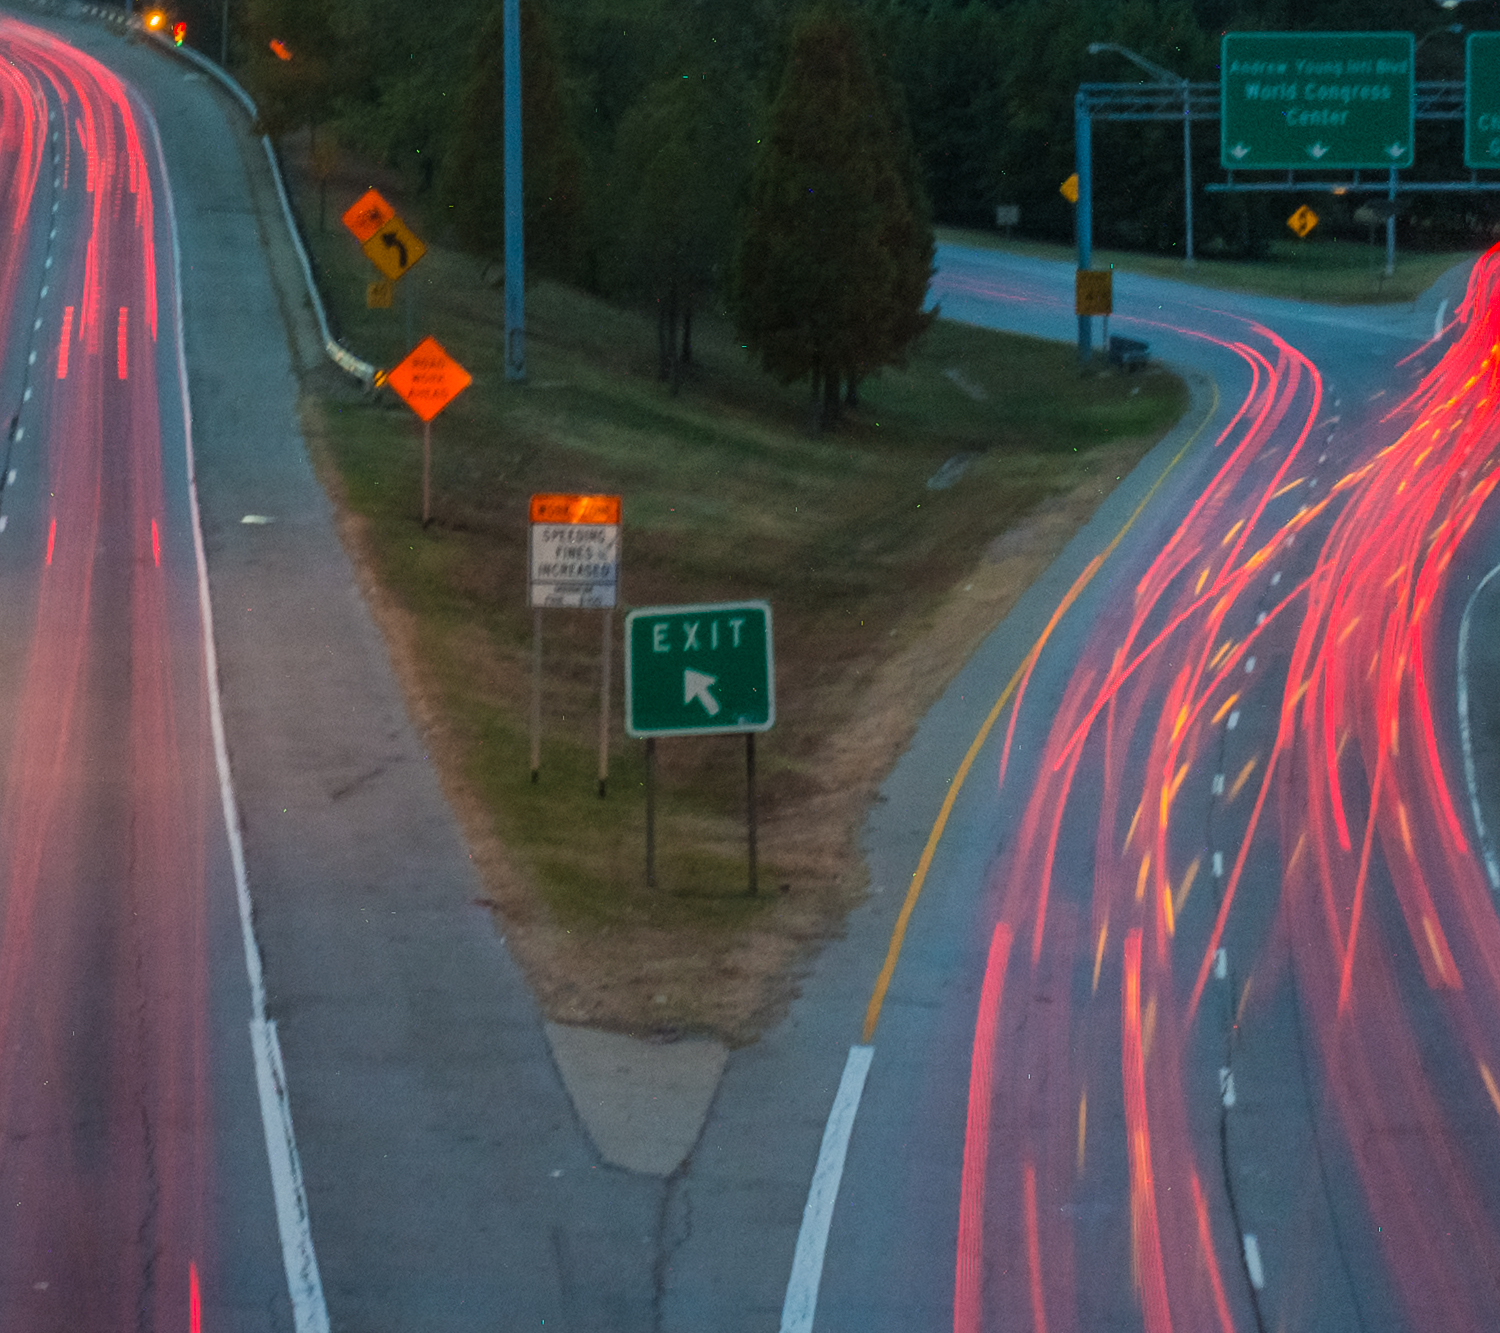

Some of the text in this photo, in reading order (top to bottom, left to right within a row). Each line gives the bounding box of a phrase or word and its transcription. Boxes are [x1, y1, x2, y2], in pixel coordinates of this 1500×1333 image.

[1229, 59, 1288, 76] Andrew
[1295, 58, 1343, 78] Young
[1244, 81, 1393, 104] World Congress
[1285, 106, 1349, 127] Center
[543, 529, 605, 544] SPEEDING
[555, 546, 593, 560] FINES
[538, 562, 612, 578] INCREASED
[652, 617, 746, 653] EXIT
